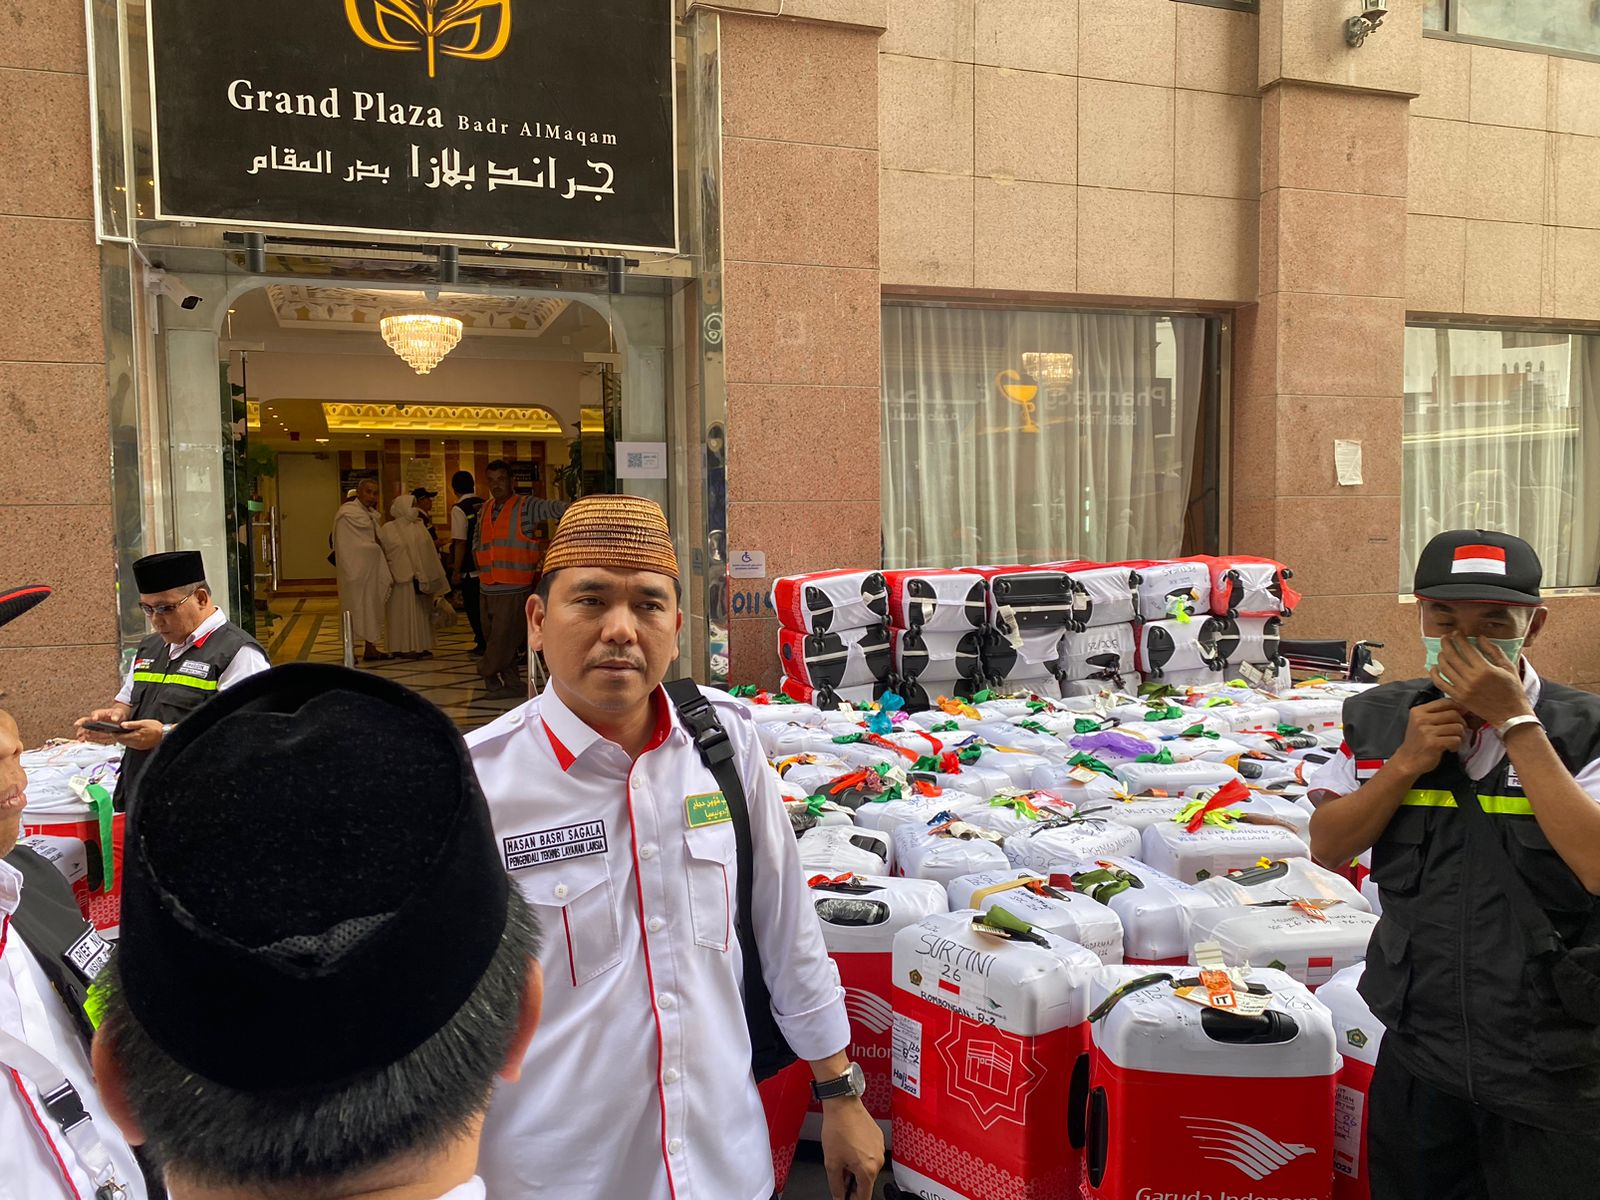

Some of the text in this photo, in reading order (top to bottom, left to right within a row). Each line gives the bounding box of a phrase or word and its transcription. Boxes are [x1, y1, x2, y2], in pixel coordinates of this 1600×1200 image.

[227, 79, 617, 146] Grand Plaza Badr AlMaqam
[246, 143, 616, 202] جراند بلازا بدر المقام
[507, 823, 602, 852] HASAN BASRI SAGALA
[509, 851, 540, 868] PENGENDALI
[585, 839, 604, 852] LANSIA
[73, 942, 92, 964] ARIEF
[915, 933, 997, 977] SURTINI
[941, 964, 961, 981] 26
[1215, 995, 1229, 1005] IT
[893, 1068, 908, 1088] Haji
